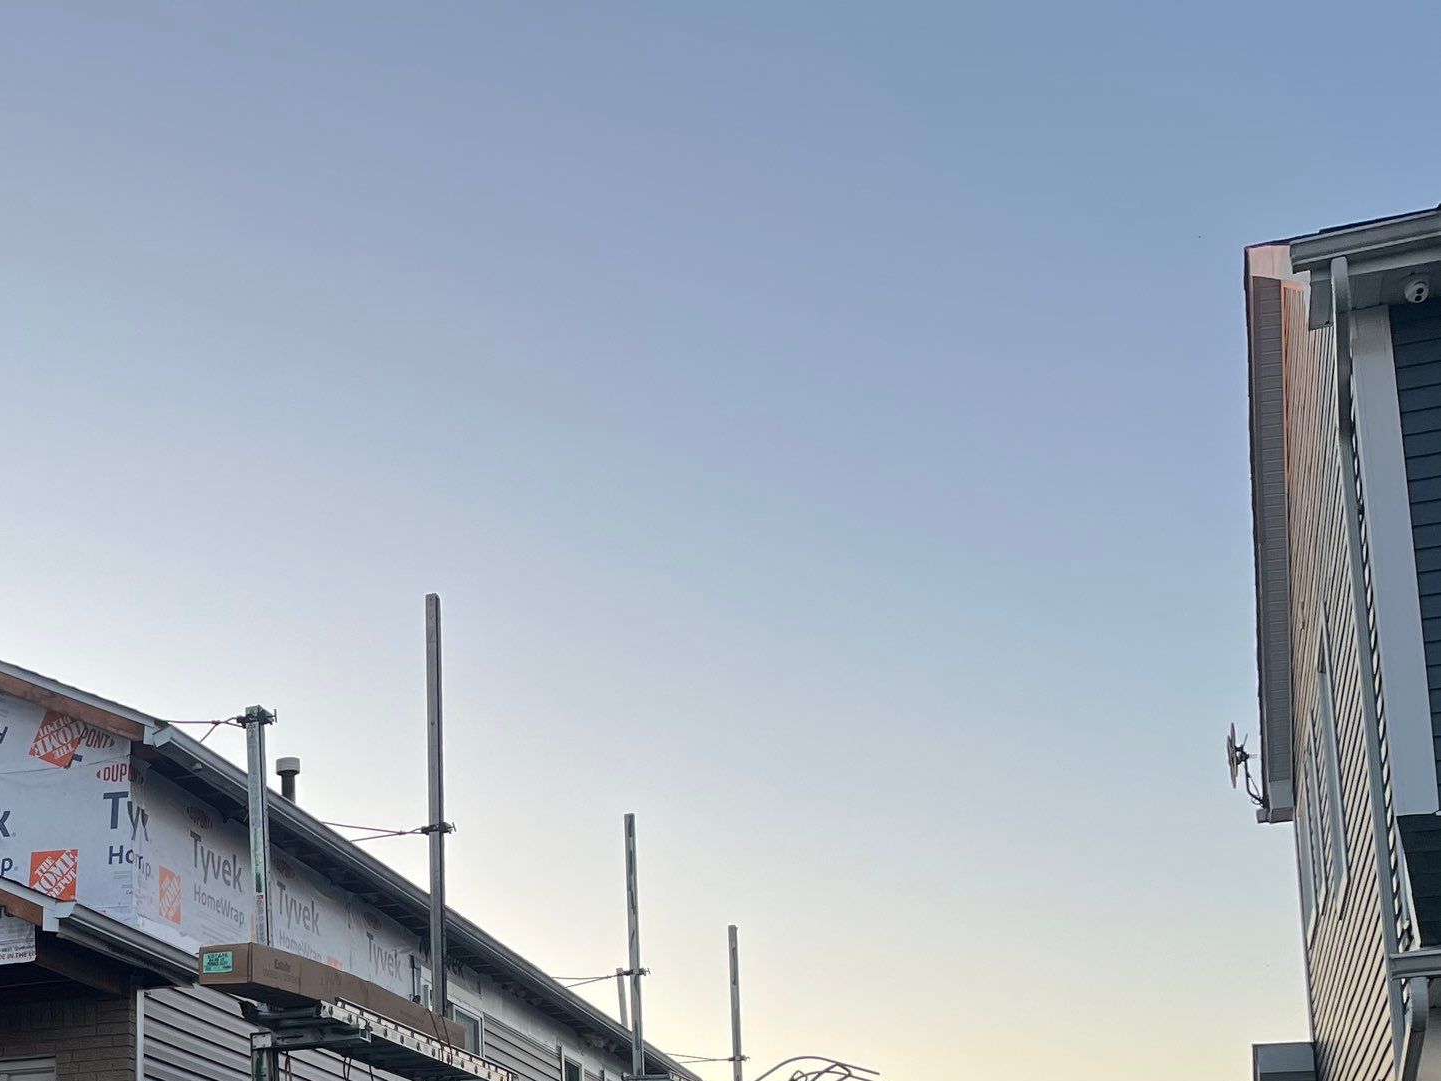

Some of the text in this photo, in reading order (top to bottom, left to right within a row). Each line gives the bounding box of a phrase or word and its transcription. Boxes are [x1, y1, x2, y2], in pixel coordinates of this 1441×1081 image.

[81, 727, 110, 749] PONT
[34, 857, 55, 878] THE
[190, 830, 243, 893] Tyvek
[193, 883, 245, 928] HomeWrap
[276, 881, 320, 936] Tyvek
[366, 931, 403, 982] Tyvek
